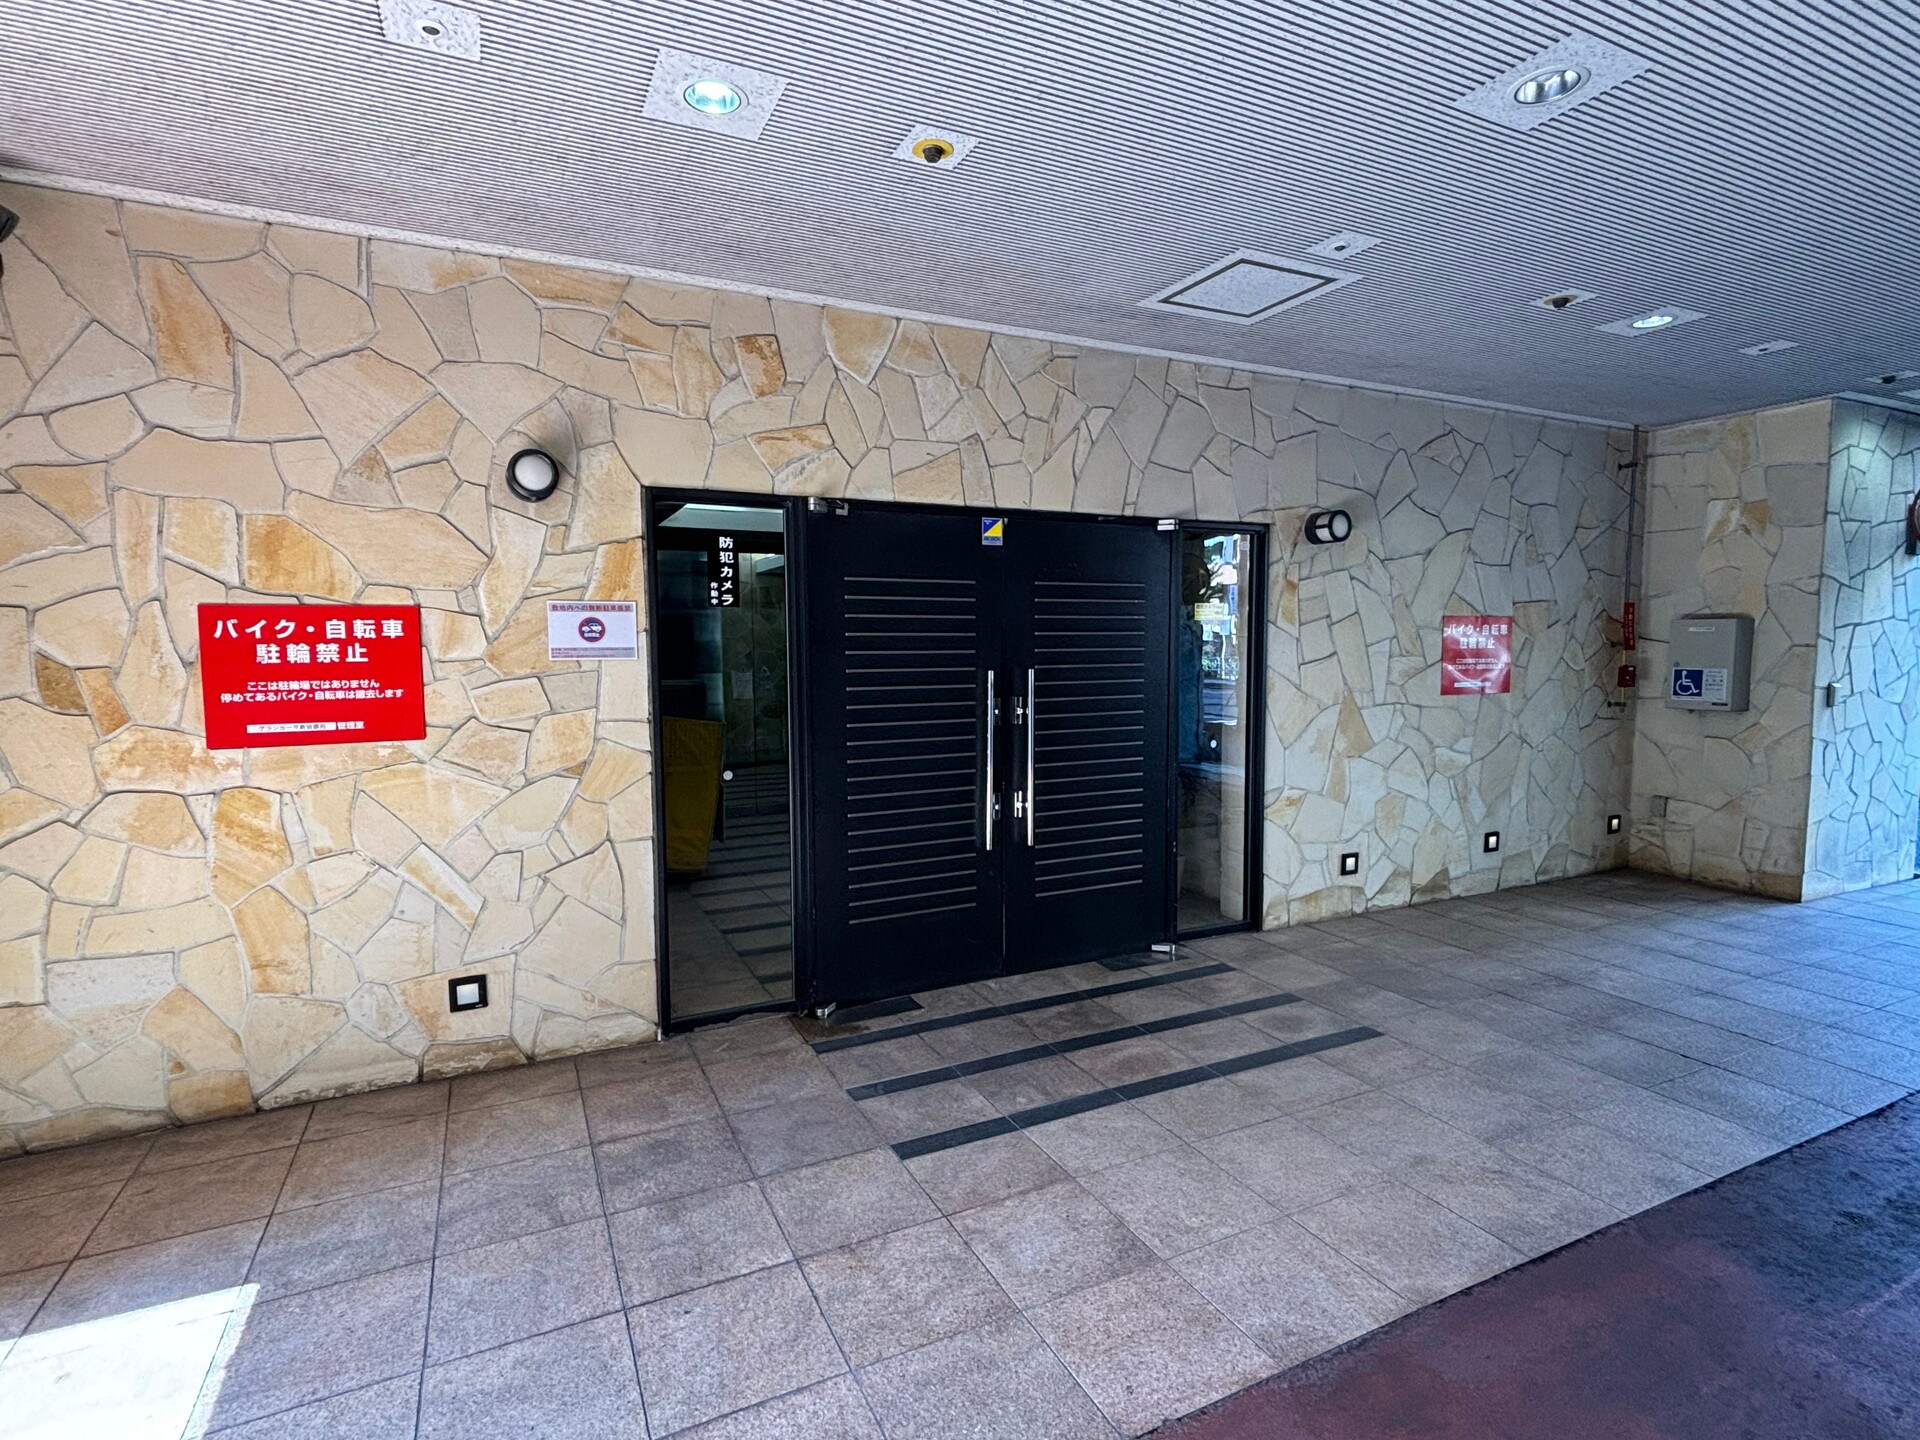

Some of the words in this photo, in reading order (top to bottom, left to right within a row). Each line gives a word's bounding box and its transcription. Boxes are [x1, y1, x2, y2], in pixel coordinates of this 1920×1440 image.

[718, 536, 735, 606] 防犯カメラ
[710, 582, 719, 606] 作動中
[213, 619, 405, 639] バイク・自転車
[255, 643, 369, 664] 駐輪禁止
[246, 679, 380, 691] ここは駐輪場ではありません
[220, 688, 405, 704] 停めてあるバイク・自転車は撤去します
